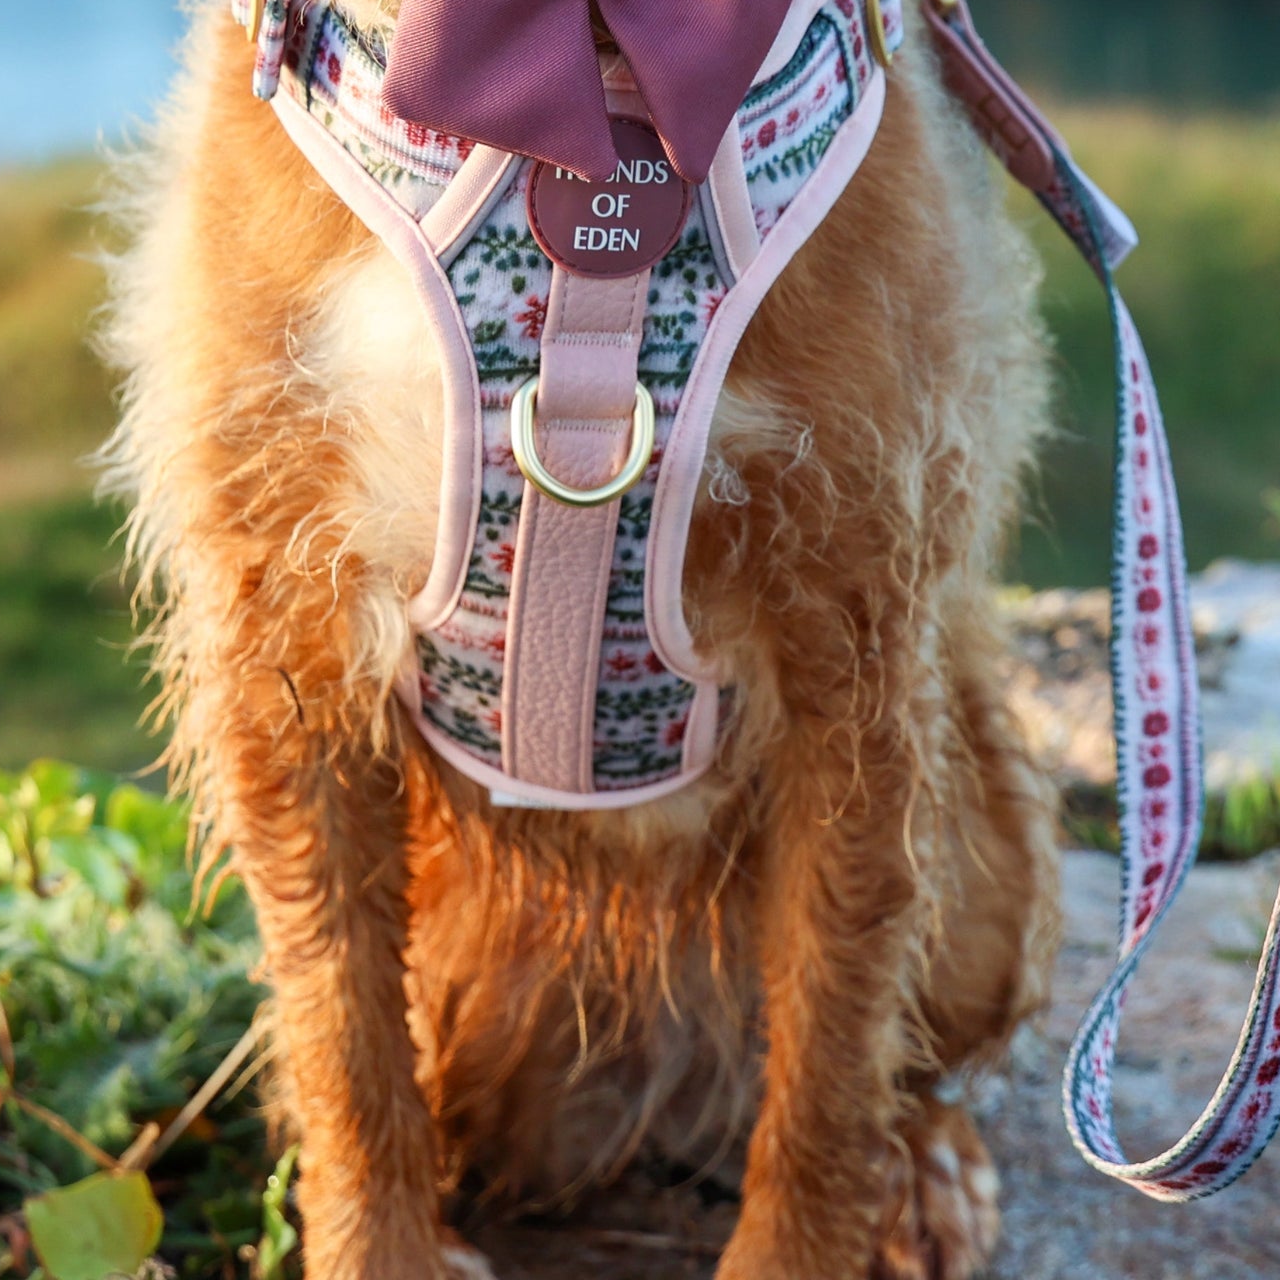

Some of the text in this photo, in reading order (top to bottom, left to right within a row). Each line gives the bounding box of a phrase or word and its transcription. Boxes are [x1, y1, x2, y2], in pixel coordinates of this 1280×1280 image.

[555, 159, 669, 185] NDS
[591, 193, 631, 218] OF
[573, 226, 640, 252] EDEN
